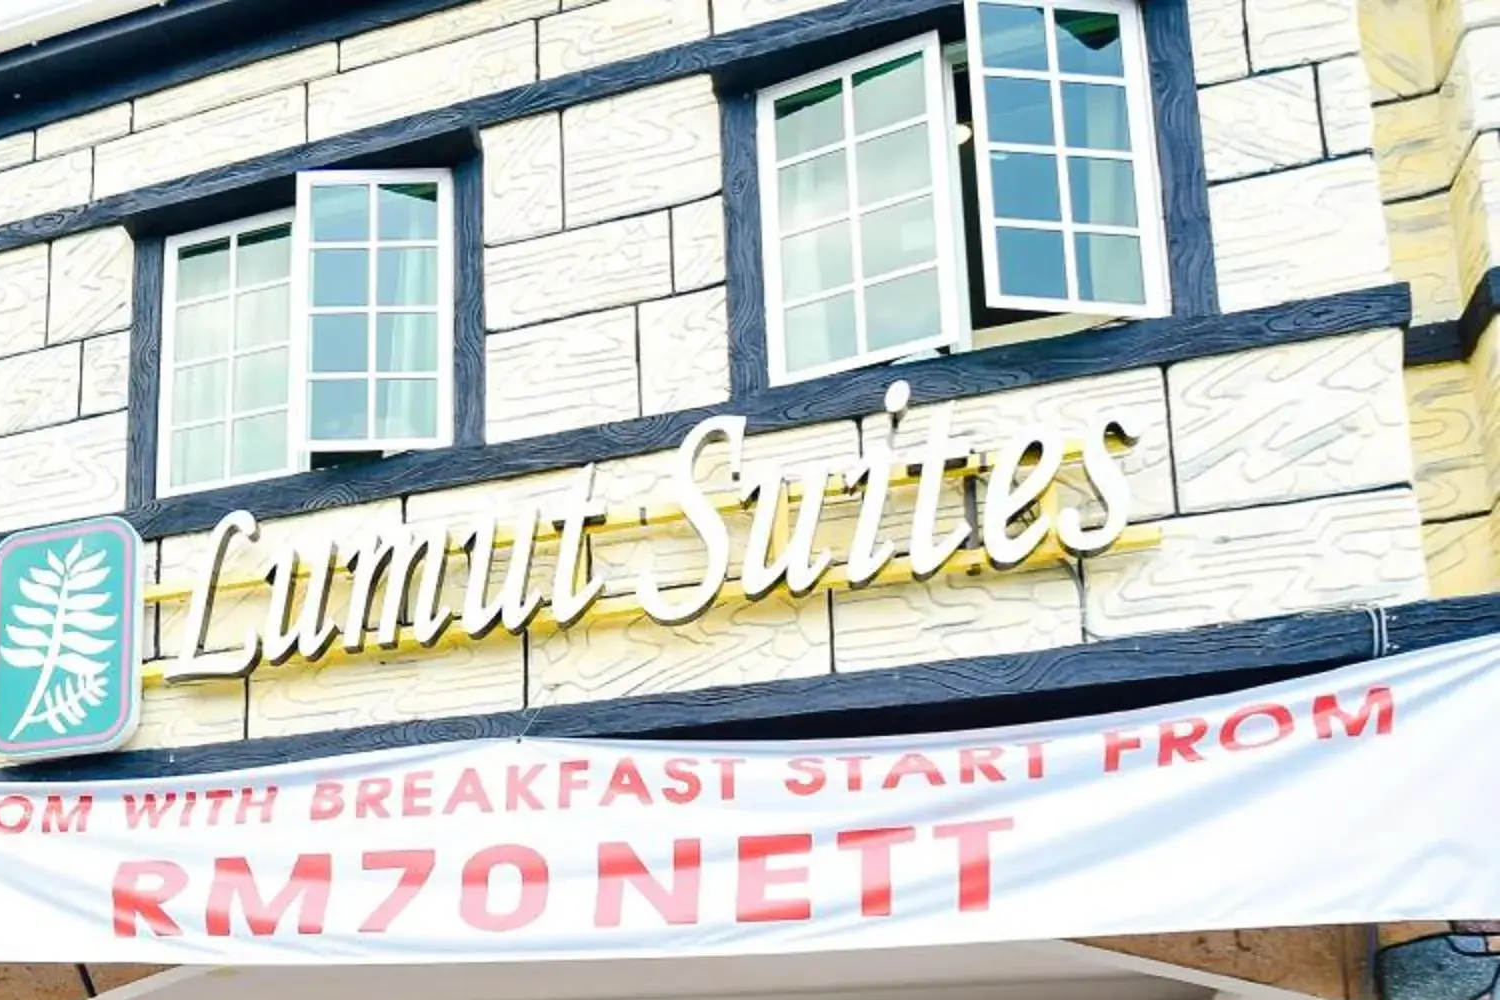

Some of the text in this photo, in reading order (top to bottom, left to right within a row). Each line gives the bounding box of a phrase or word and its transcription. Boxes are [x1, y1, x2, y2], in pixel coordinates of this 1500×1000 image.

[164, 380, 1140, 684] Lumut Suites
[123, 786, 277, 828] WITH
[309, 757, 747, 821] BREAKFAST
[784, 742, 1046, 795] START
[1103, 684, 1394, 773] FROM
[112, 818, 1015, 938] RM70 NETT
